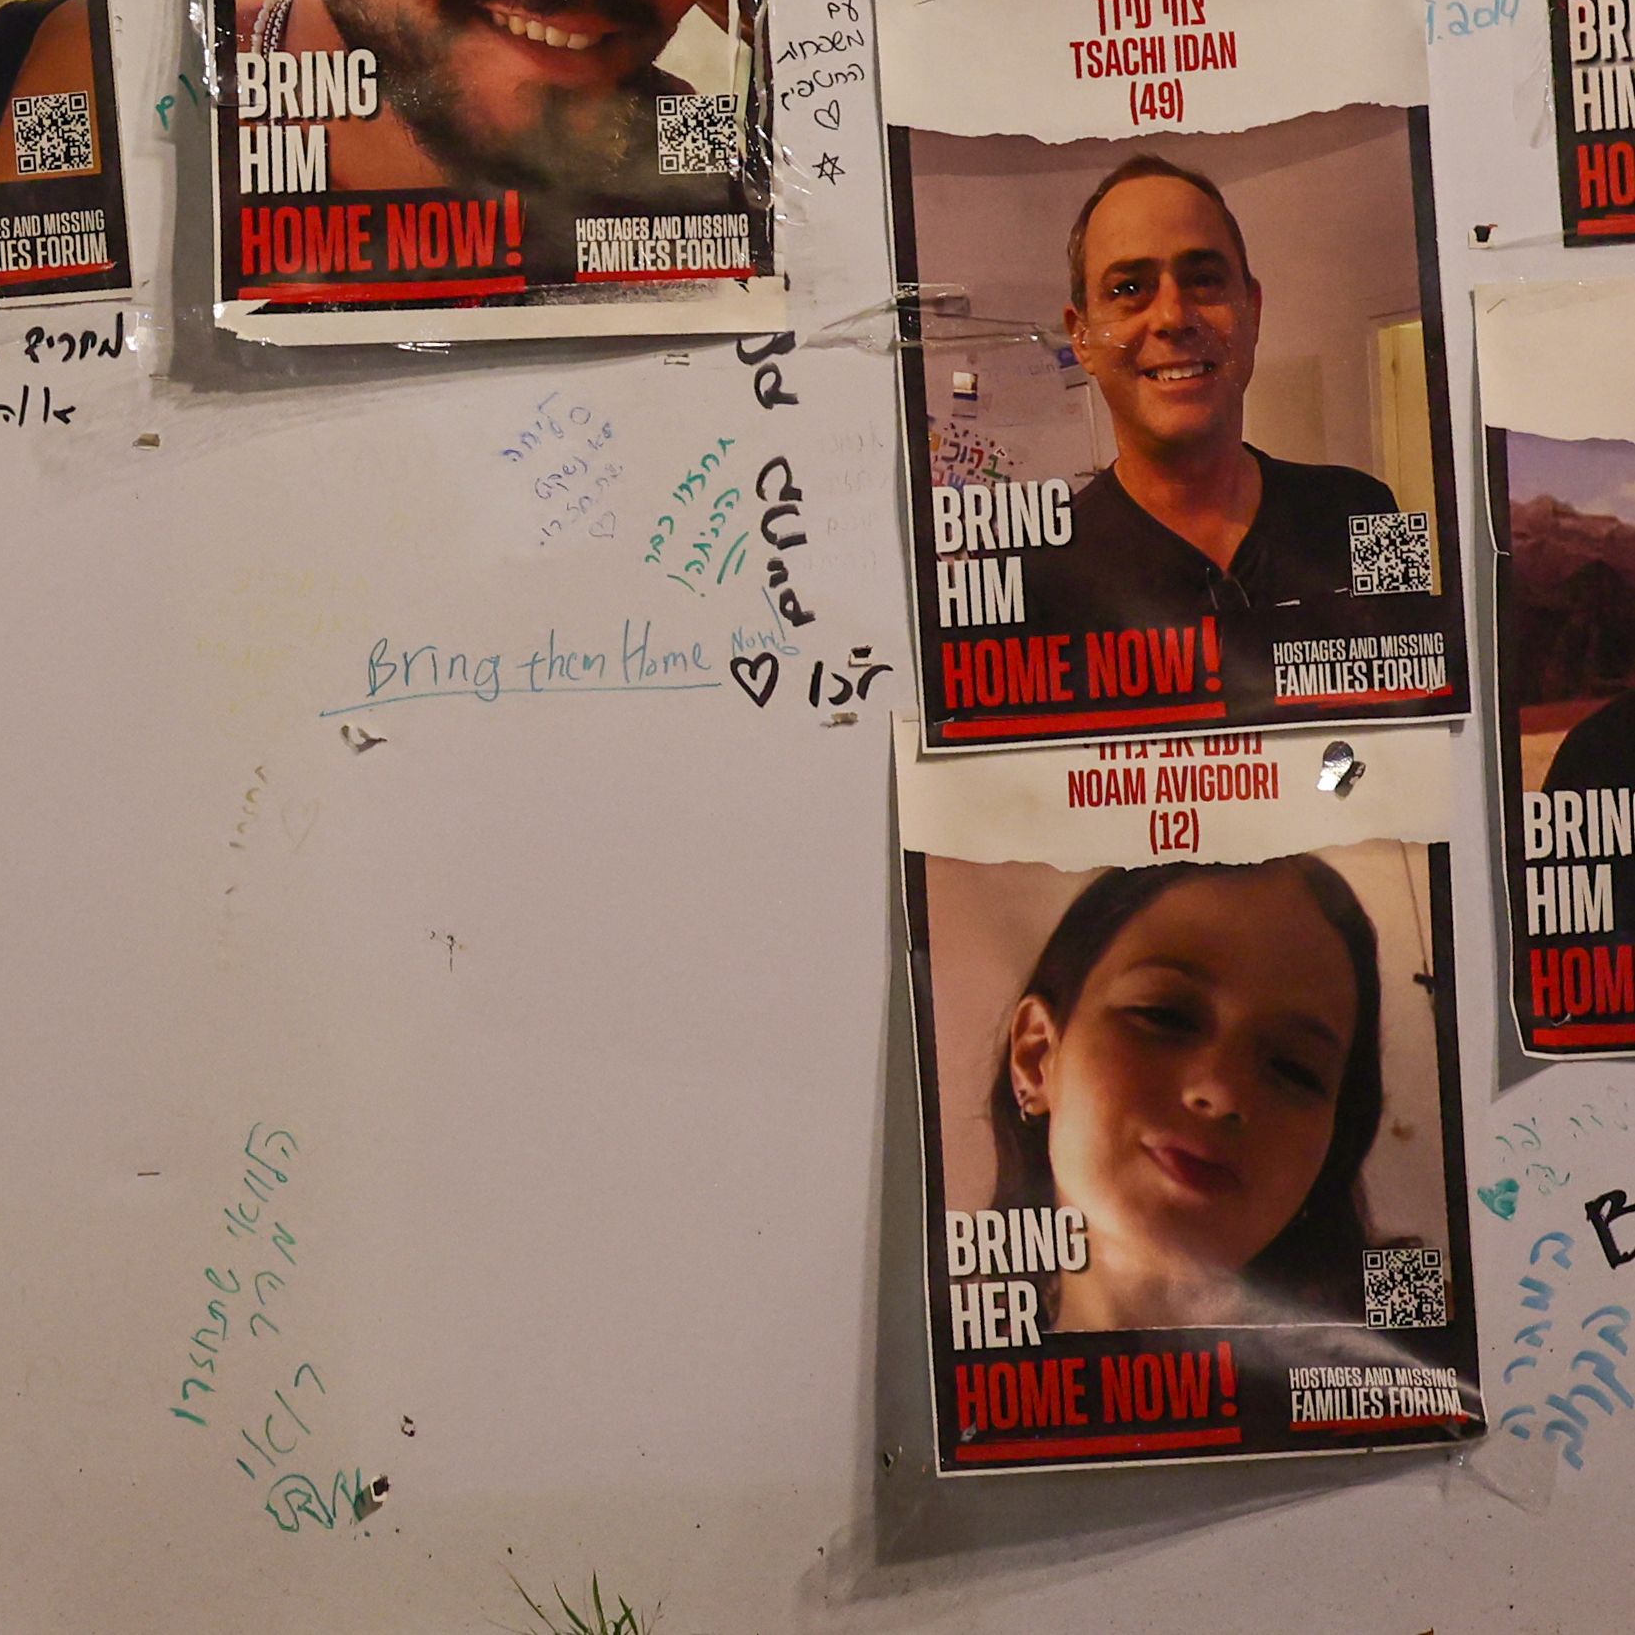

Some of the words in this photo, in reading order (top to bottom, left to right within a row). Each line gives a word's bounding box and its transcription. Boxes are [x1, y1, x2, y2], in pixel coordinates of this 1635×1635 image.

[1070, 36, 1166, 78] TSACHI
[1174, 32, 1236, 71] IDAN
[1130, 79, 1183, 125] (49)
[366, 638, 500, 702] Bring
[622, 619, 711, 671] Home
[1068, 768, 1146, 807] NOAM
[1156, 763, 1278, 803] AVIGDORI
[1150, 808, 1199, 854] (12)
[1526, 864, 1613, 935] HIM
[1289, 1367, 1362, 1389] HOSTAGES
[1365, 1367, 1393, 1387] AND
[1395, 1367, 1457, 1388] MISSING
[1292, 1389, 1383, 1422] FAMILIES
[1389, 1386, 1463, 1417] FORUM
